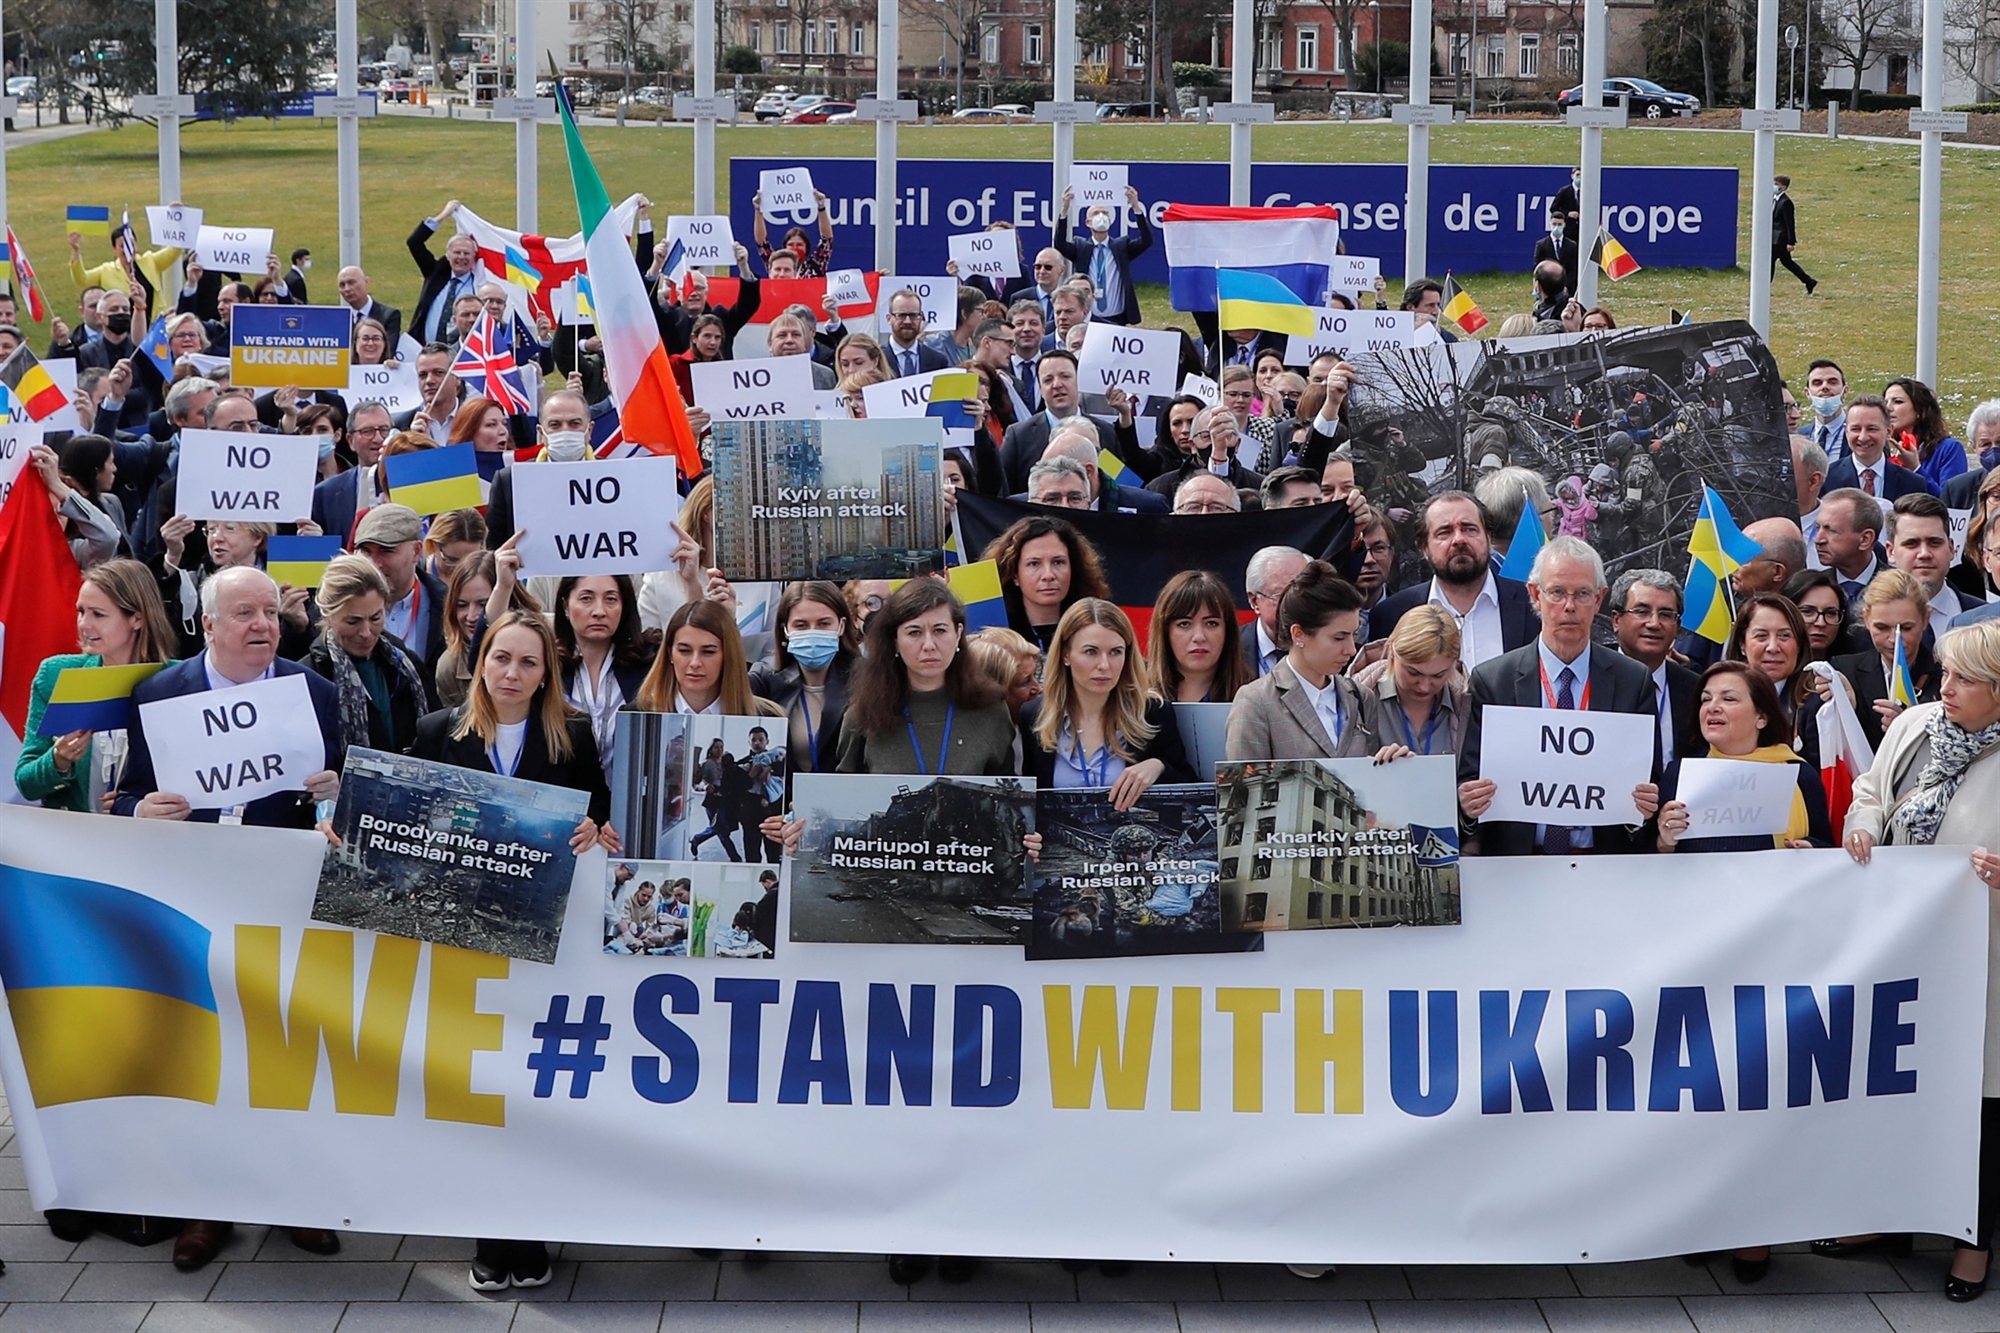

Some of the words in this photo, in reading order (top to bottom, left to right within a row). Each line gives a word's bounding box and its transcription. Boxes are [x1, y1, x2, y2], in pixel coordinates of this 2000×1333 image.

[776, 174, 796, 185] NO
[1089, 171, 1108, 181] NO
[773, 192, 803, 205] WAR
[1084, 190, 1114, 200] WAR
[166, 210, 182, 222] NO
[763, 188, 929, 226] ounil
[947, 188, 996, 227] of
[1444, 193, 1499, 231] de
[162, 230, 186, 242] WAR
[223, 232, 246, 242] NO
[690, 222, 713, 235] NO
[686, 246, 719, 258] WAR
[971, 238, 993, 252] NO
[214, 250, 250, 266] WAR
[1350, 260, 1365, 270] NO
[968, 261, 1003, 274] WAR
[838, 274, 850, 284] NO
[1344, 277, 1368, 286] WAR
[835, 290, 859, 300] WAR
[906, 284, 930, 298] NO
[1320, 316, 1347, 332] NO
[1374, 316, 1396, 328] NO
[243, 336, 264, 345] WE
[266, 336, 304, 346] STAND
[308, 337, 339, 346] WITH
[1112, 336, 1144, 354] NO
[1367, 340, 1401, 350] WAR
[242, 348, 338, 366] UKRAINE
[364, 372, 390, 384] NO
[733, 368, 771, 389] NO
[1100, 368, 1150, 386] WAR
[1199, 384, 1215, 398] NO
[725, 401, 786, 418] WAR
[226, 445, 271, 468] NO
[568, 476, 621, 506] NO
[777, 487, 822, 502] Kyiv
[826, 486, 880, 500] after
[211, 490, 280, 510] WAR
[752, 504, 833, 520] Russian
[838, 502, 907, 517] attack
[555, 530, 640, 560] WAR
[202, 701, 258, 736] NO
[1541, 726, 1596, 755] NO
[195, 753, 284, 793] WAR
[1521, 782, 1606, 810] WAR
[358, 813, 490, 852] Borodyanka
[494, 840, 552, 864] after
[1266, 830, 1349, 846] Kharkiv
[1354, 828, 1410, 843] after
[834, 836, 930, 857] Mariupol
[936, 841, 993, 858] after
[1258, 844, 1342, 860] Russian
[1348, 842, 1420, 858] attack
[368, 834, 456, 864] Russian
[461, 852, 534, 880] attack
[831, 854, 916, 870] Russian
[922, 858, 995, 875] attack
[1083, 860, 1140, 877] Irpen
[1145, 858, 1200, 872] after
[1062, 874, 1146, 889] Russian
[1150, 870, 1220, 886] attack
[235, 925, 510, 1128] WE
